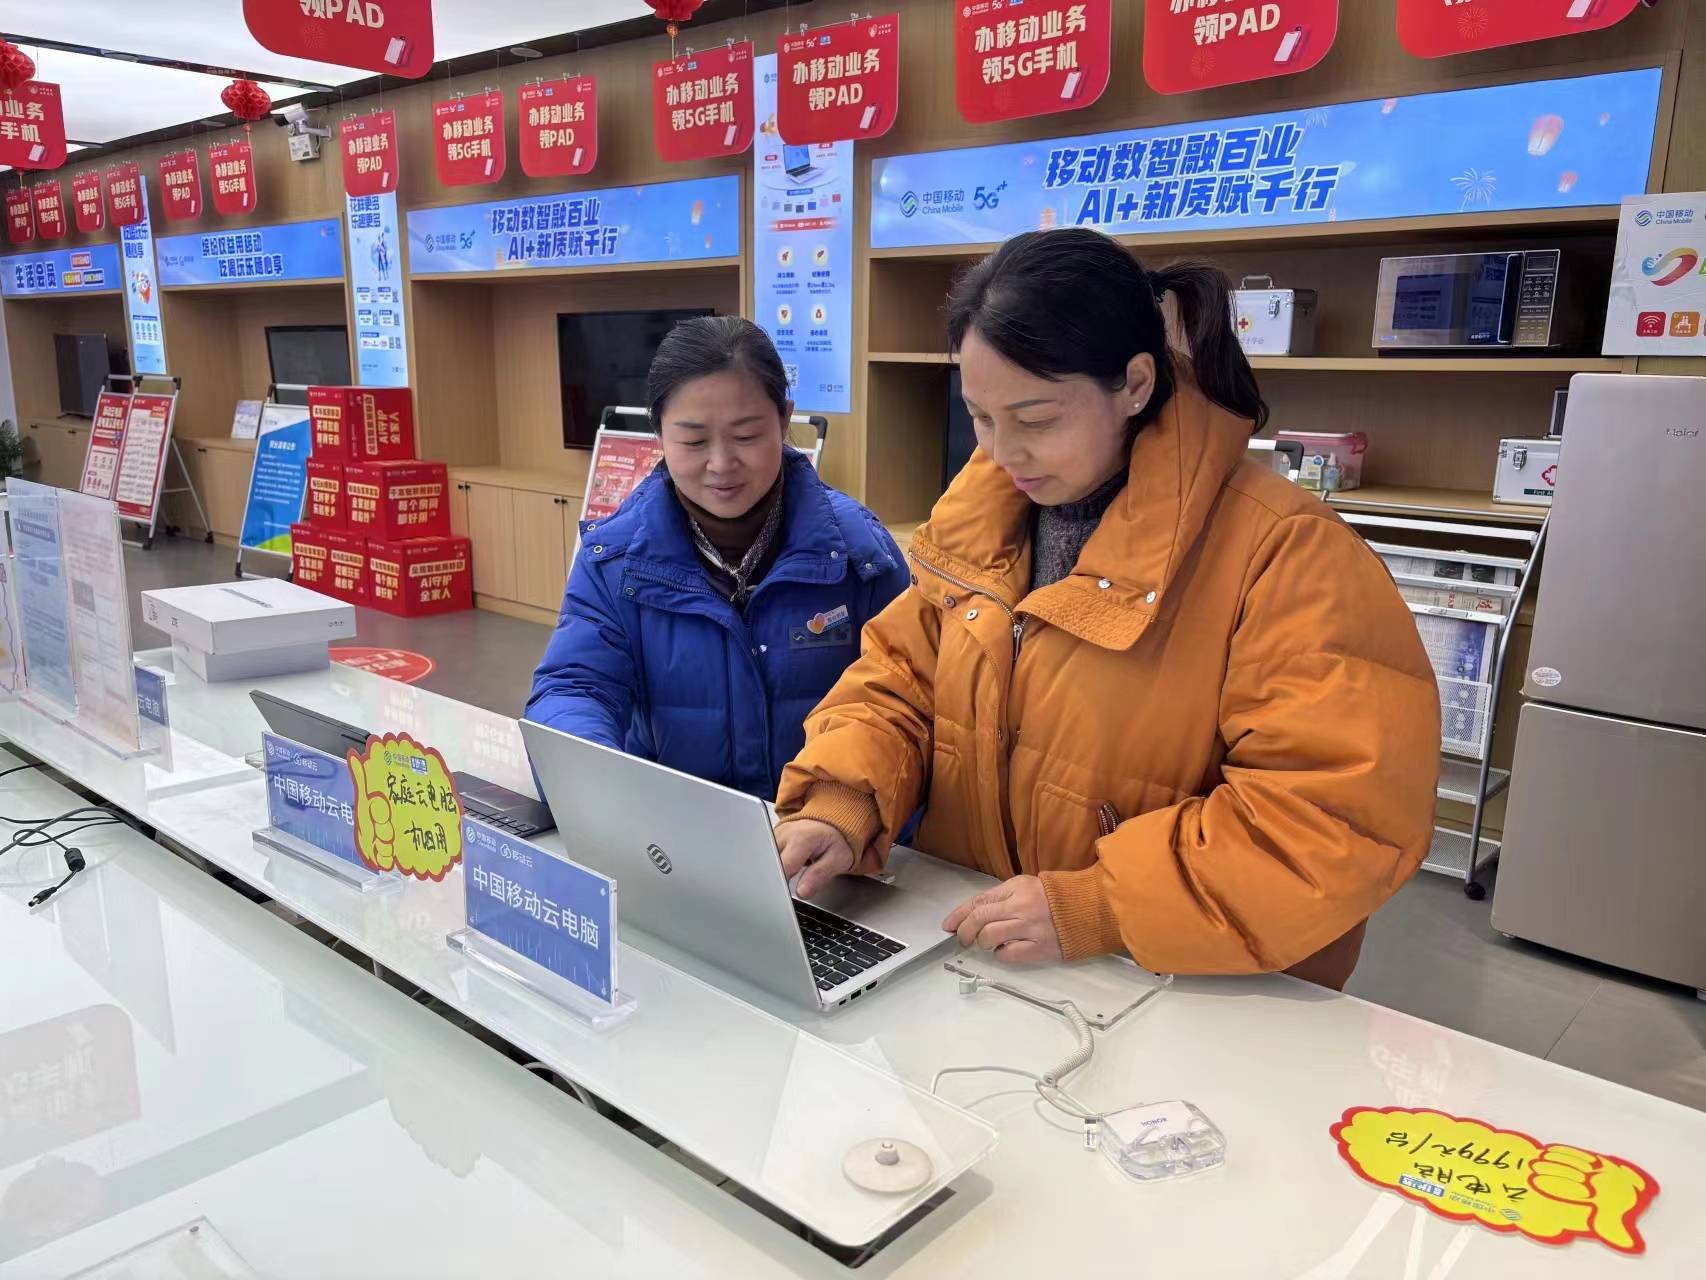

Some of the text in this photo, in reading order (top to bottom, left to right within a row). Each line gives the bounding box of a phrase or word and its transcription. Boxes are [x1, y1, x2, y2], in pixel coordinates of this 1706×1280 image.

[974, 4, 1087, 53] 办移动业务
[1193, 3, 1281, 46] 领PAD
[792, 48, 881, 84] 办移动业务
[982, 40, 1079, 84] 领5G手机
[665, 72, 739, 106] 办移动业务
[808, 83, 864, 111] 领PAD
[0, 99, 45, 121] 业务
[528, 101, 585, 127] 办移动业务
[671, 100, 735, 131] 领5G手机
[0, 121, 41, 143] 手机
[442, 115, 494, 140] 办移动业务
[539, 128, 575, 149] 领PAD
[347, 133, 389, 156] 办移动业务
[447, 138, 492, 161] 领5G手机
[1045, 123, 1303, 187] 移动数智融百业
[214, 159, 248, 178] 办移动业务
[356, 155, 383, 174] 领PAD
[165, 168, 195, 186] 办移动业务
[218, 176, 248, 195] 领5G手机
[172, 186, 191, 201] 领PAD
[922, 189, 965, 205] 中国移动
[1077, 166, 1340, 226] AI+新质赋千行
[491, 197, 601, 235] 移动数智融百业
[922, 203, 964, 215] China Mobile
[1656, 209, 1694, 219] 中国移动
[1673, 217, 1693, 225] Mobile
[508, 227, 618, 262] AI+新质赋千行
[420, 588, 451, 602] 全家人
[386, 772, 457, 814] 家庭云电脑
[472, 864, 600, 951] 中国移动云电脑
[1141, 1116, 1169, 1127] HONOR
[1413, 1162, 1529, 1203] 云电脑
